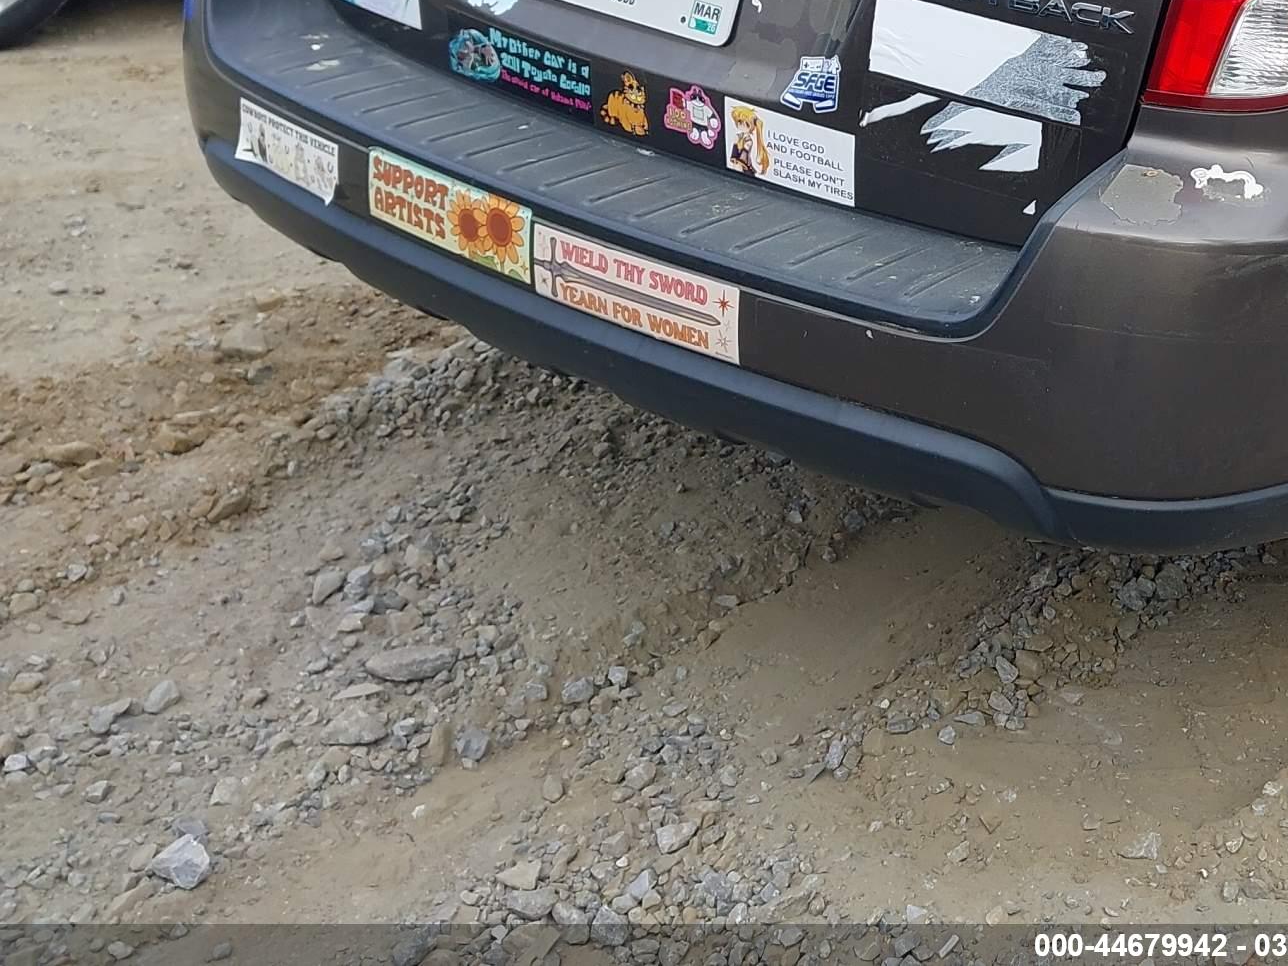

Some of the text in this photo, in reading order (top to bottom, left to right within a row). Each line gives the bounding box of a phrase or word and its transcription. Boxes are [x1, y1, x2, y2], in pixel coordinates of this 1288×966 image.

[694, 2, 720, 22] MAR
[521, 60, 558, 83] Toyota
[567, 58, 577, 74] is
[581, 65, 590, 79] a
[309, 137, 336, 157] VEHICLE
[767, 141, 844, 172] AND FOOTBALL
[773, 132, 799, 147] LOVE
[802, 139, 825, 154] GOD
[373, 156, 449, 210] SUPPORT
[773, 158, 845, 187] PLEASE DON'T
[773, 168, 853, 200] SLASH MY TIRES
[374, 187, 446, 240] ARTISTS
[560, 240, 708, 306] WIELD THY SWORD
[559, 282, 709, 350] YEARN FOR WOMEN
